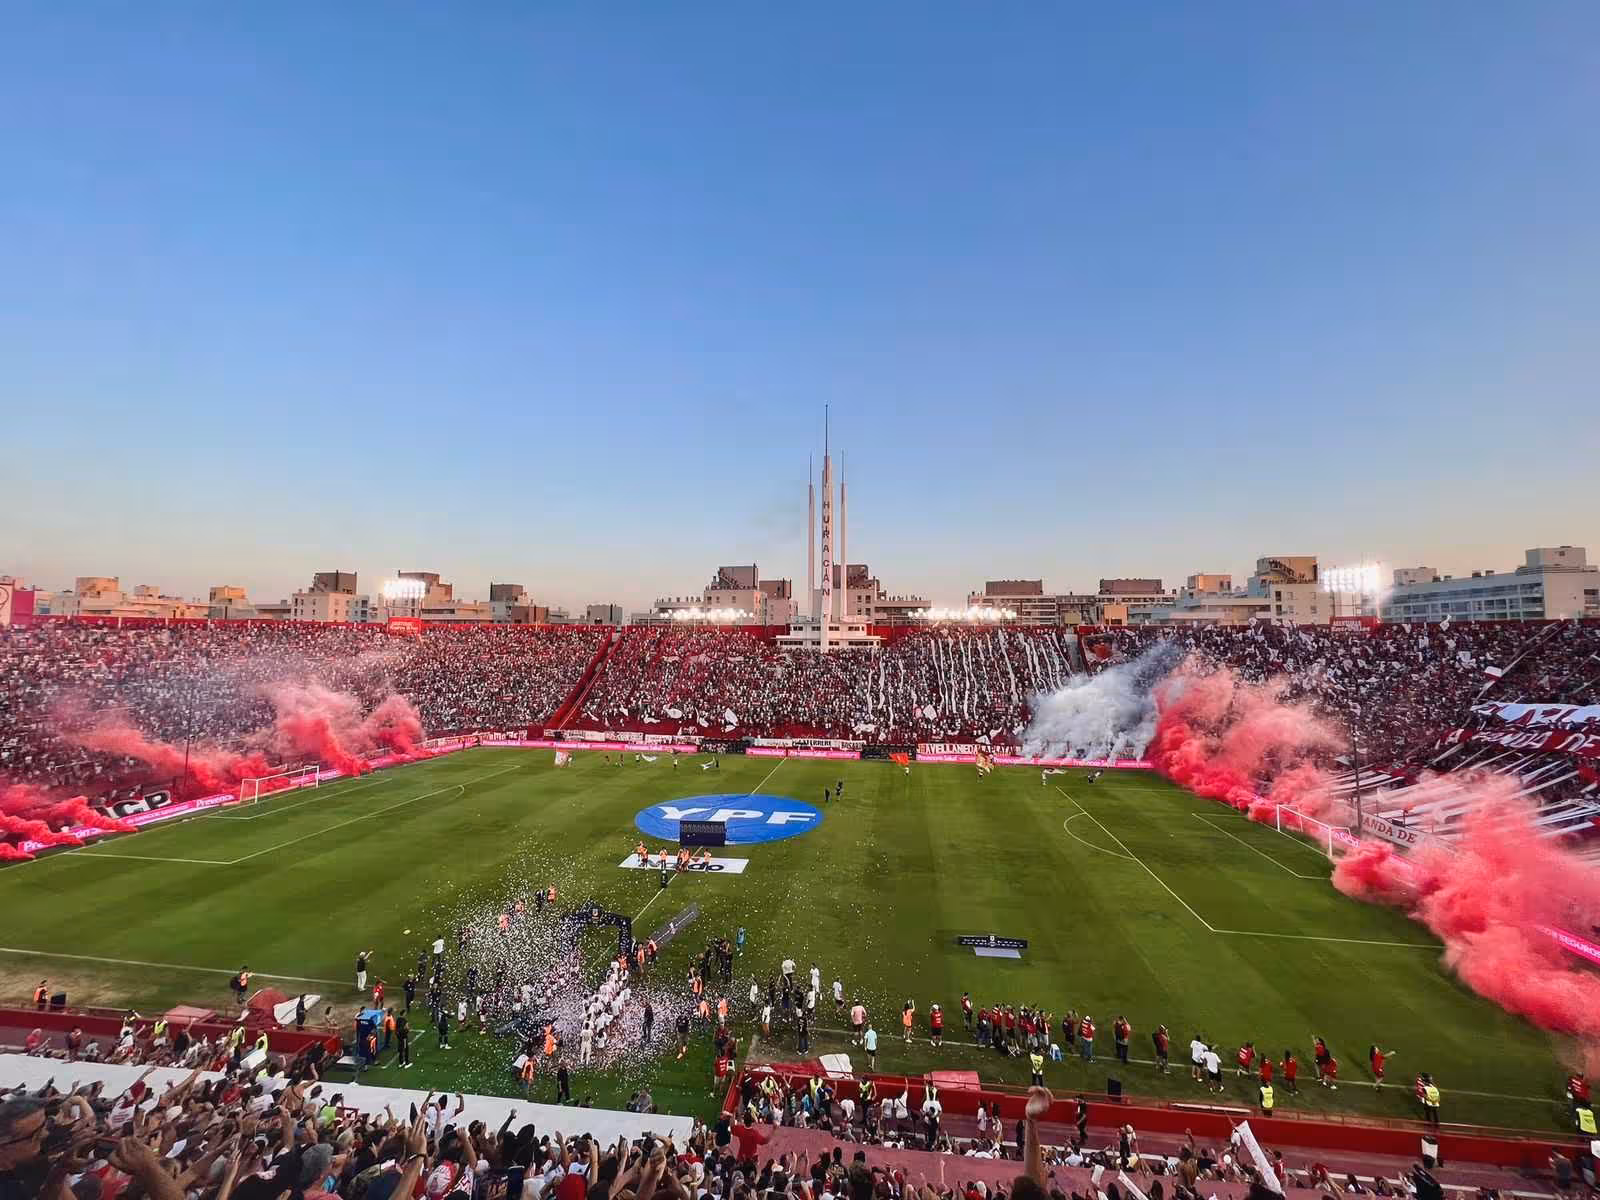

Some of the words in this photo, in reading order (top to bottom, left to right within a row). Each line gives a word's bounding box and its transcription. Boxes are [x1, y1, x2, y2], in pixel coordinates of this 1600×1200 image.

[658, 806, 817, 824] YPF
[1361, 819, 1393, 836] ANDA
[1398, 829, 1417, 843] DE
